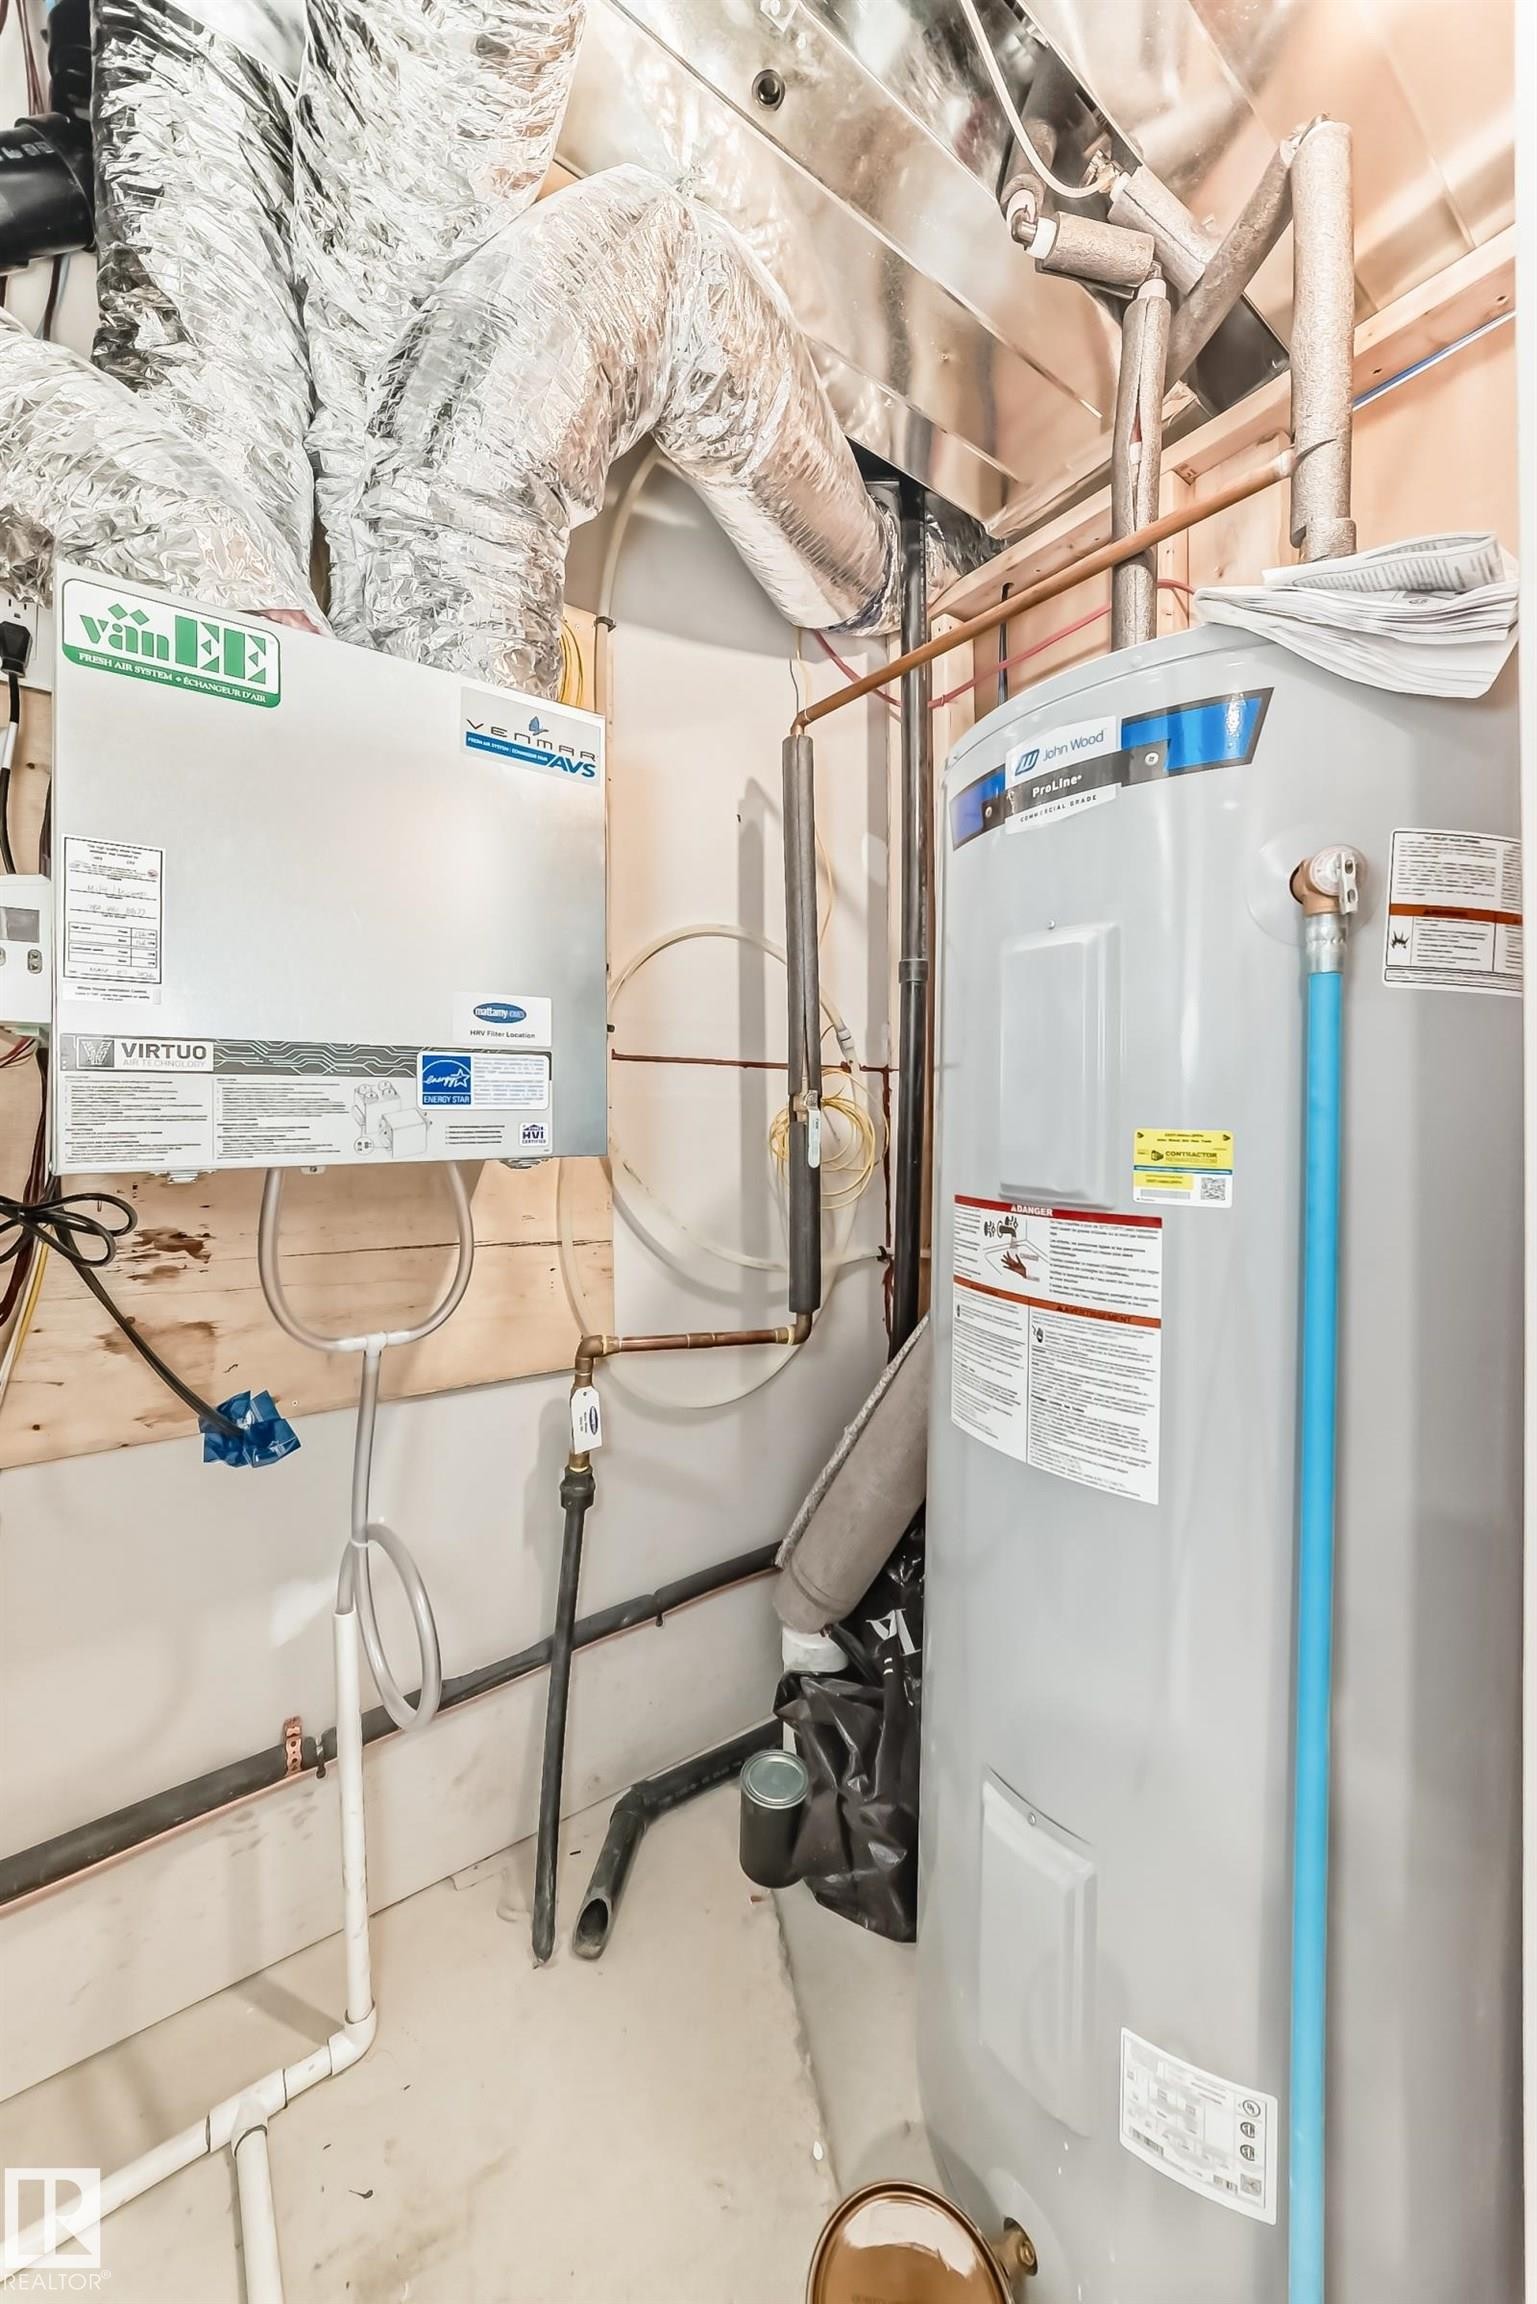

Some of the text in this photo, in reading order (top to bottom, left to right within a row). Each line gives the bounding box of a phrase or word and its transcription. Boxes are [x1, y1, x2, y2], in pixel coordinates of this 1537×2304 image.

[78, 652, 113, 667] FRESH
[114, 660, 133, 673] AIR
[134, 665, 173, 681] SYSTEM
[183, 676, 241, 697] ÉCHANGEUR
[1042, 730, 1104, 762] John Wood
[549, 755, 597, 778] AVS
[1020, 794, 1097, 823] COMMERCIAL GRADE
[487, 1030, 505, 1038] Filter
[506, 1031, 536, 1039] Location
[121, 1042, 207, 1060] VIRTUO
[122, 1058, 206, 1069] AIR TECHNOLOGY
[423, 1094, 470, 1104] ENERGY STAR
[522, 1130, 544, 1140] HVI
[1165, 1150, 1217, 1158] CONTRACTOR
[1017, 1205, 1054, 1217] DANGER
